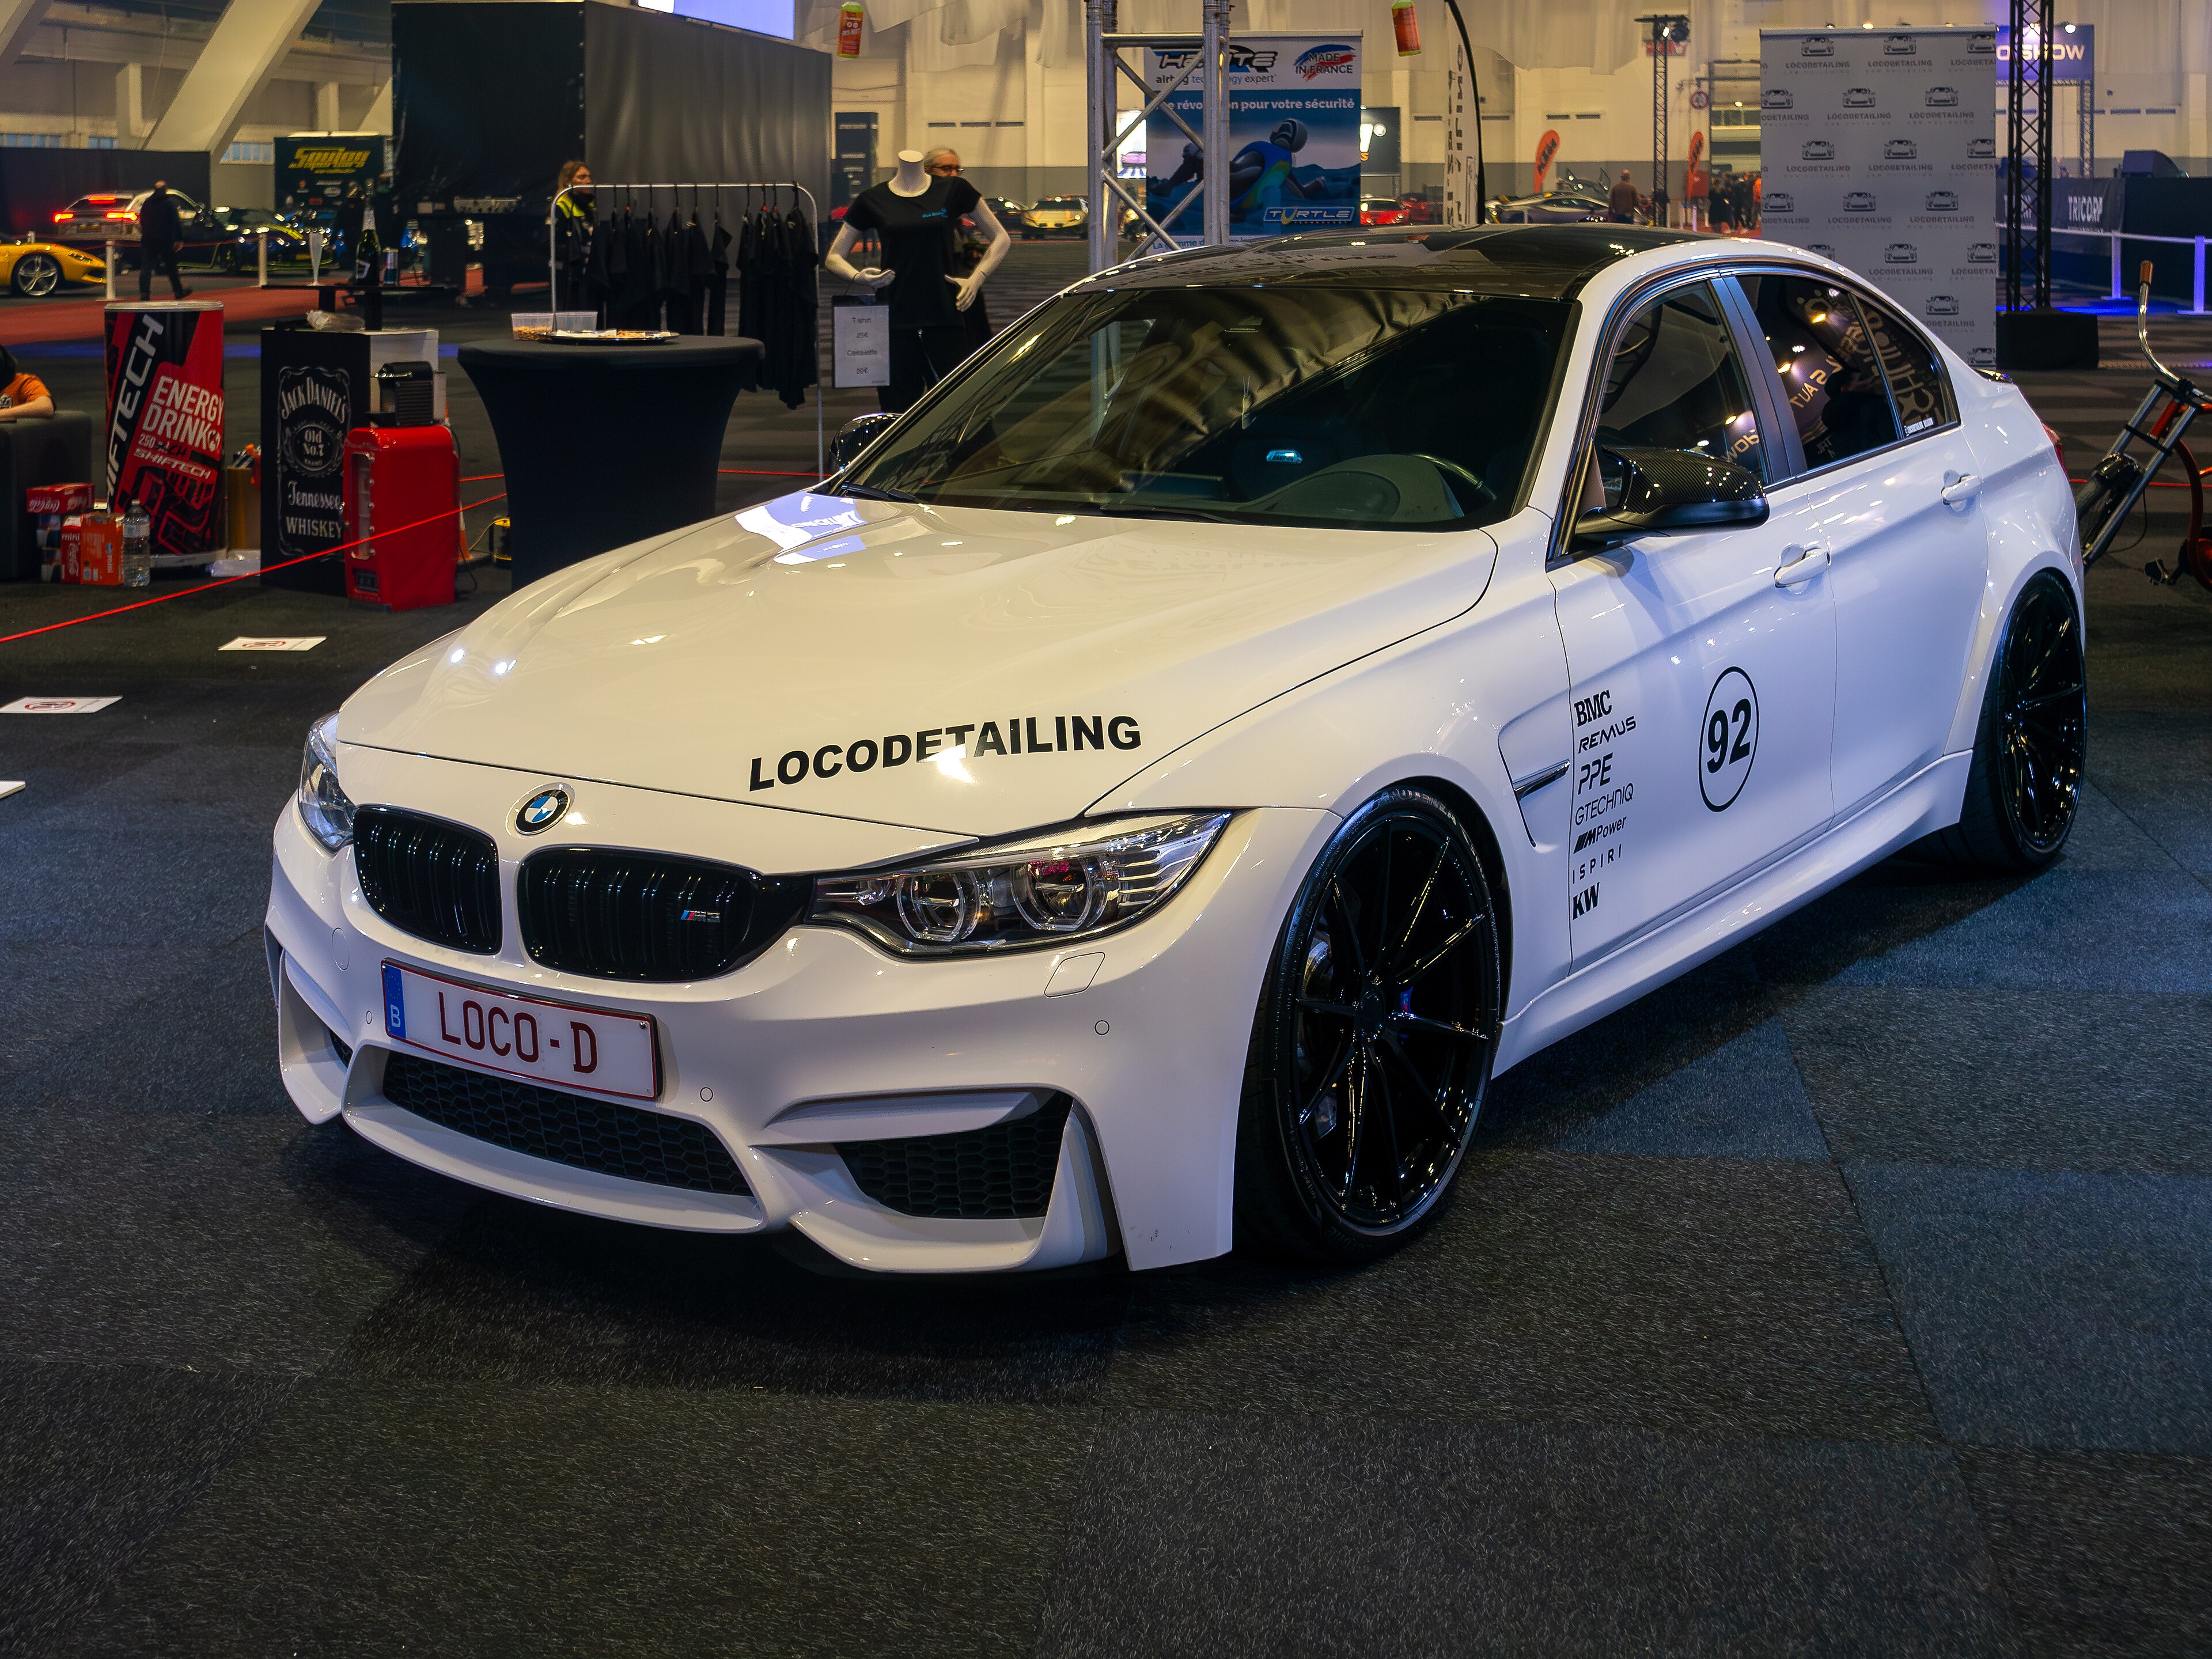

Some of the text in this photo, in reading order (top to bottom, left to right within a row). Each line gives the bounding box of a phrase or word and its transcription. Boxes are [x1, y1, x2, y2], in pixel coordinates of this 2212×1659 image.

[1309, 54, 1340, 62] MADE
[2022, 43, 2085, 60] SHOW
[1296, 65, 1353, 74] IN FRANCE
[1786, 61, 1850, 69] LOCODETAILING
[1868, 59, 1933, 68] LOCODETAILING
[1245, 75, 1274, 85] expert
[1241, 101, 1268, 112] pour
[1270, 100, 1302, 109] votre
[1305, 98, 1355, 109] sécurité
[1909, 111, 1975, 120] LOCODETAILING
[1786, 164, 1851, 172] LOCODETAILING
[1868, 164, 1933, 172] LOCODETAILING
[1269, 209, 1351, 225] TURTLE
[1910, 215, 1975, 224] LOCODETAILING
[1869, 267, 1933, 275] LOCODETAILING
[152, 376, 224, 426] ENERGY
[282, 385, 306, 420] JACK
[304, 430, 323, 444] Old
[134, 447, 211, 479] SHIFTECH
[288, 480, 342, 510] Tennessee
[286, 516, 342, 539] WHISKEY
[1574, 690, 1613, 728] BMC
[1578, 715, 1637, 754] REMUS
[1706, 698, 1752, 774] 92
[748, 715, 1142, 792] LOCODETAILING
[1578, 752, 1613, 796] PPE
[1572, 843, 1623, 885] ISPIRI
[1572, 881, 1600, 921] KW
[390, 1003, 402, 1028] B
